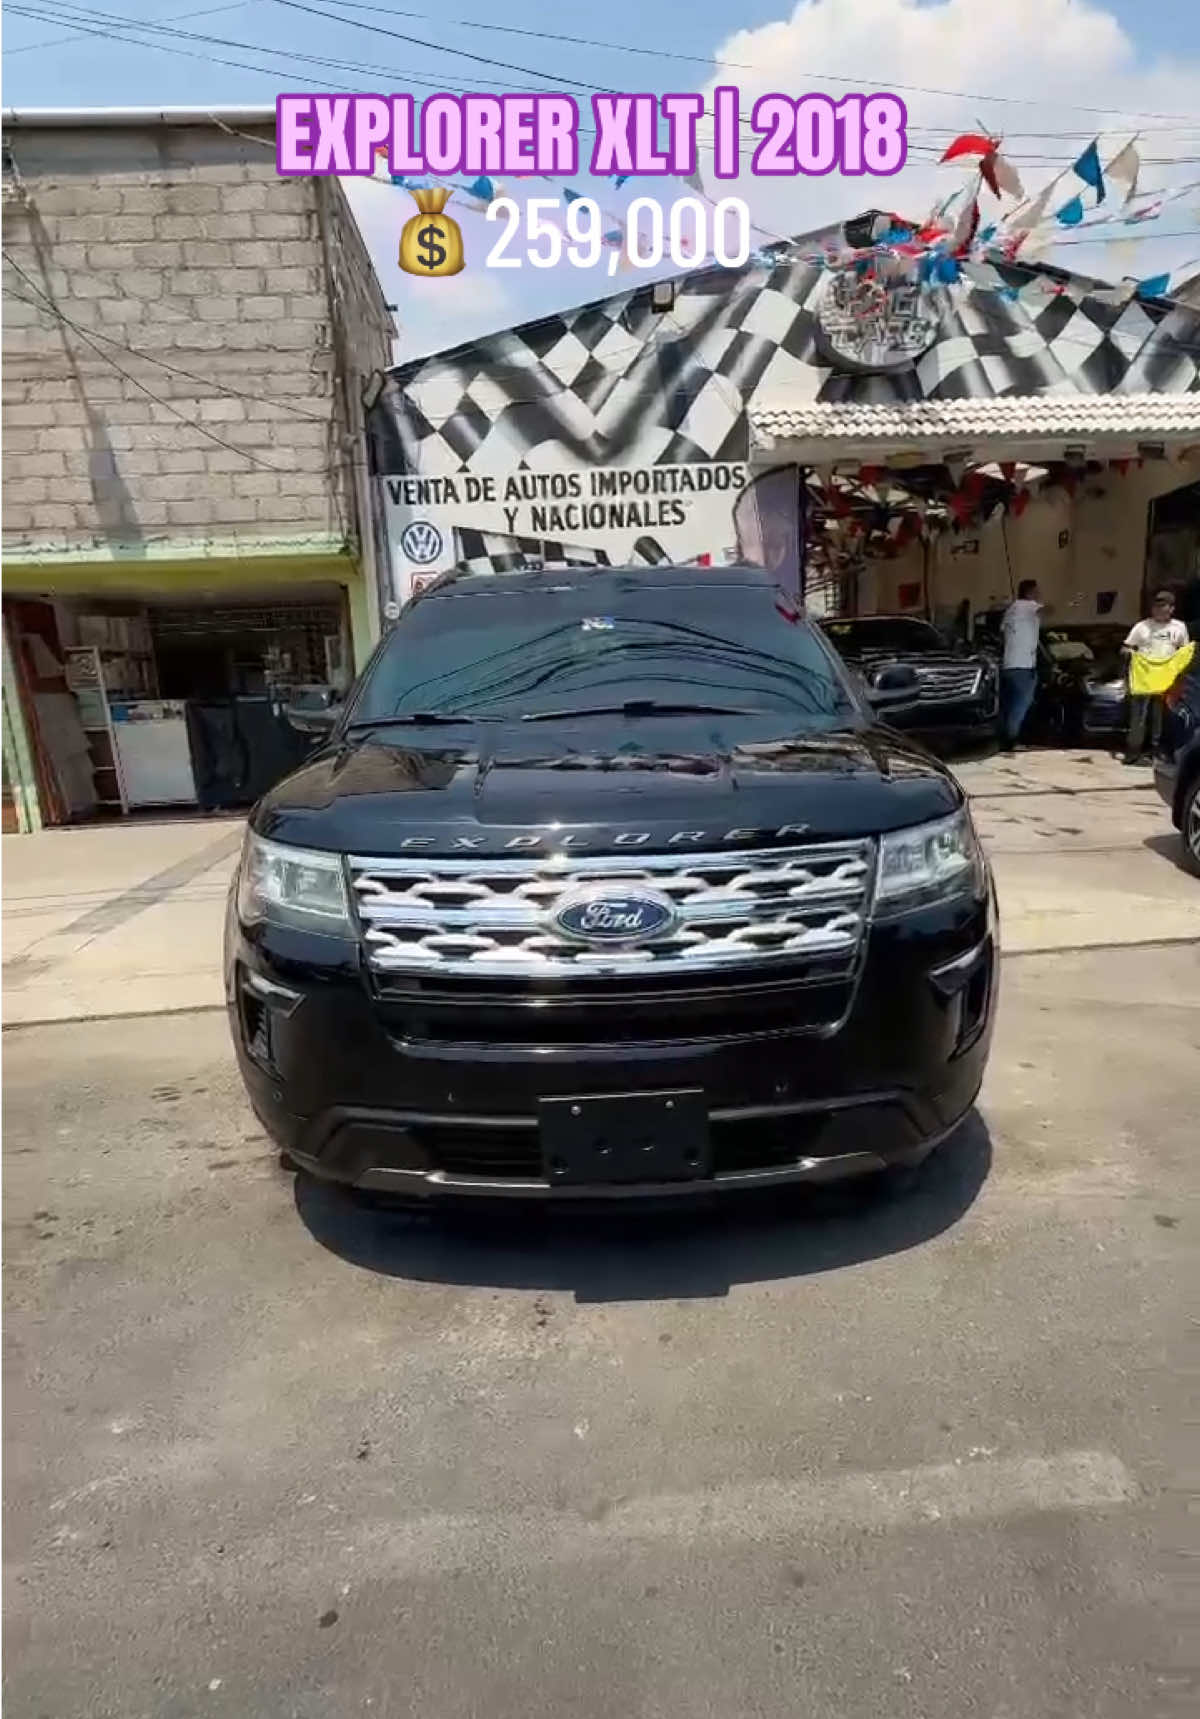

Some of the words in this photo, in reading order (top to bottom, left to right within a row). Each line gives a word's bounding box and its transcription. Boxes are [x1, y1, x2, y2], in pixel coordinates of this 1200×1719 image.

[387, 476, 461, 505] VENTA
[464, 477, 497, 502] DE
[503, 473, 582, 501] AUTOS
[590, 465, 746, 497] IMPORTADOS
[503, 506, 519, 532] Y
[531, 499, 686, 532] NACIONALES
[400, 823, 810, 849] EXPLORER
[580, 901, 644, 929] Ford
